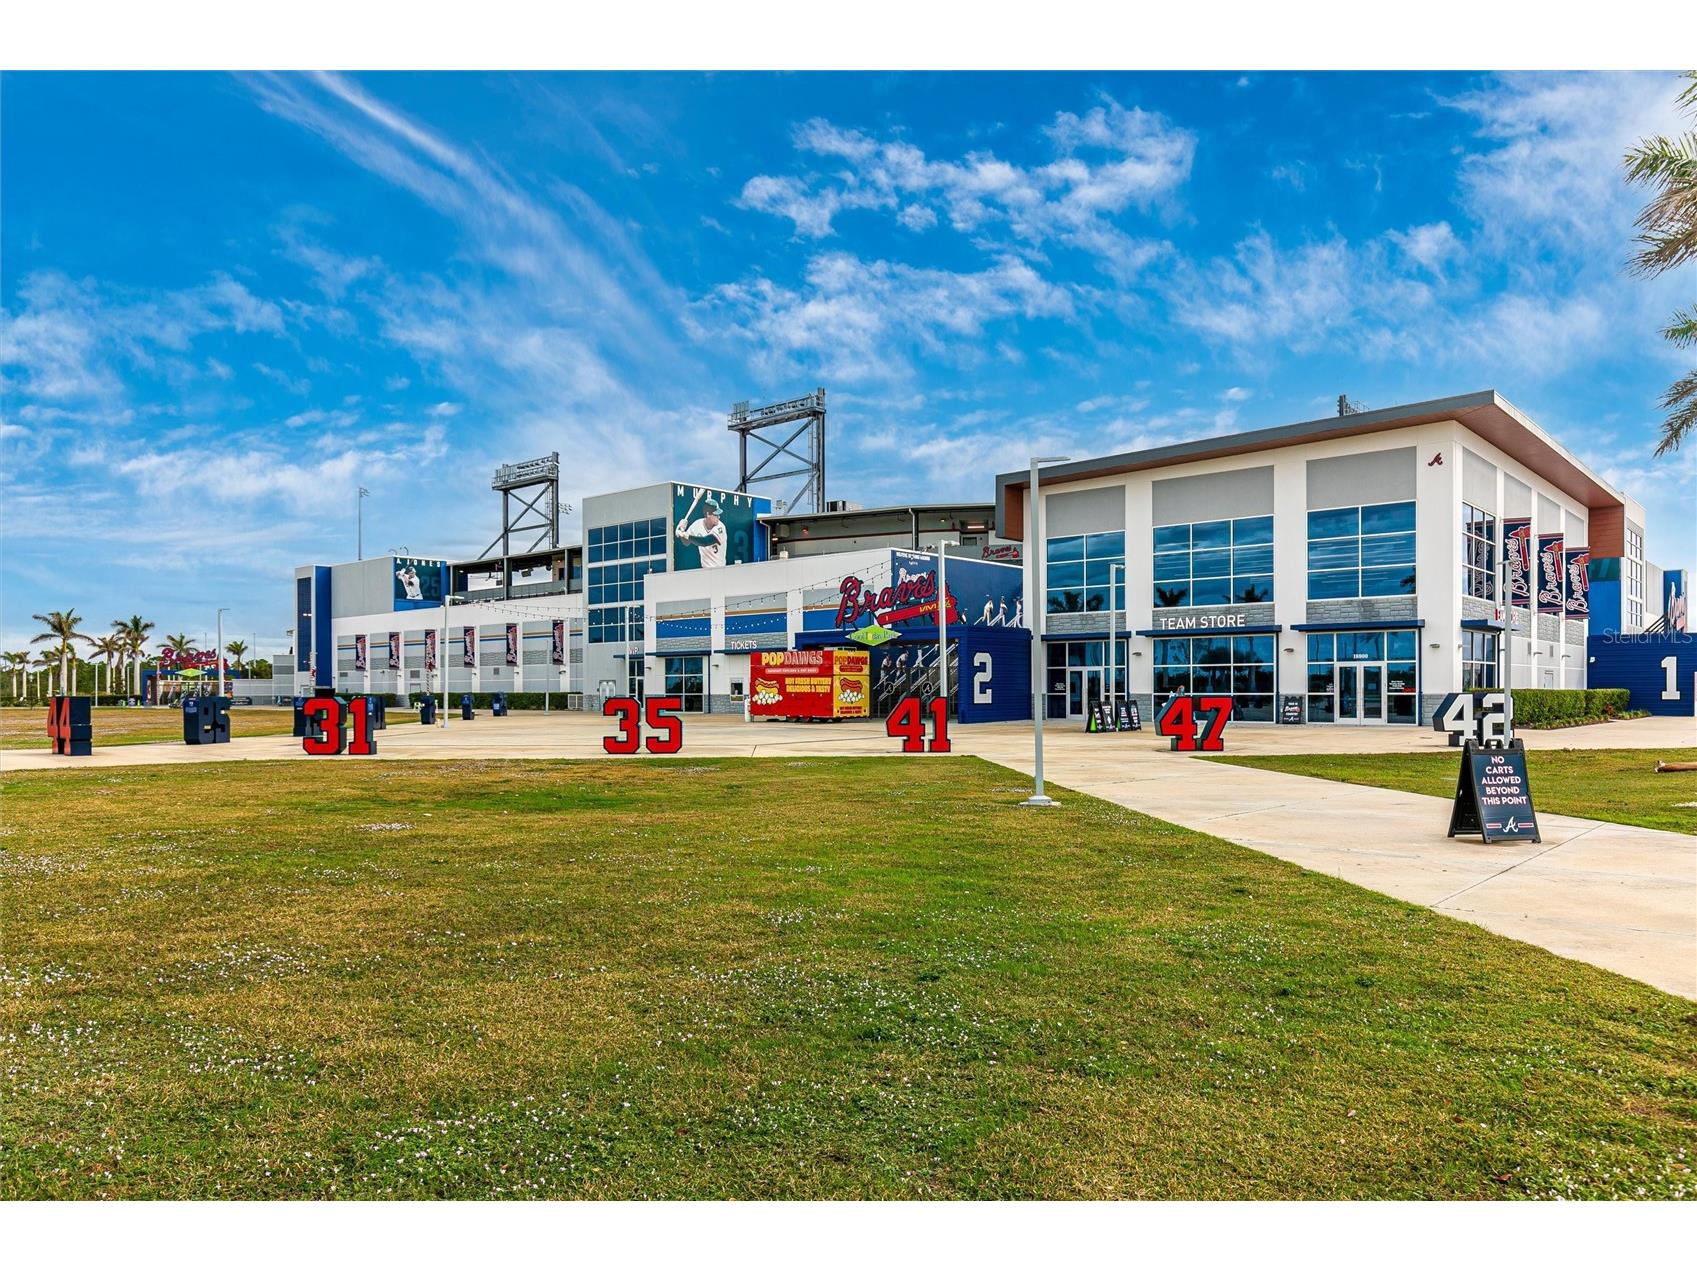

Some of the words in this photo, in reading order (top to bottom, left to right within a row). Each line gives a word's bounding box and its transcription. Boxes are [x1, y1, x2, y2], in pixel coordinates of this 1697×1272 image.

[677, 485, 753, 508] MURPHY
[1503, 538, 1530, 597] Braves
[1538, 551, 1564, 605] Braves
[1566, 563, 1590, 613] Braves
[834, 570, 936, 628] Braves
[1160, 617, 1196, 630] TEAM
[1200, 614, 1246, 628] STORE
[731, 640, 758, 650] TICKETS
[762, 651, 823, 665] POPDAWGS
[974, 652, 993, 704] 2
[1661, 656, 1681, 700] 1
[47, 696, 72, 756] 44
[303, 696, 371, 755] 31
[603, 697, 682, 754] 35
[886, 696, 951, 752] 41
[1160, 697, 1233, 751] 47
[1443, 693, 1514, 747] 42
[1481, 776, 1521, 785] ALLOWED
[1485, 766, 1514, 774] CARTS
[1491, 756, 1505, 764] NO
[1482, 797, 1501, 805] THIS
[1502, 797, 1527, 805] POINT
[1485, 787, 1520, 795] BEYOND
